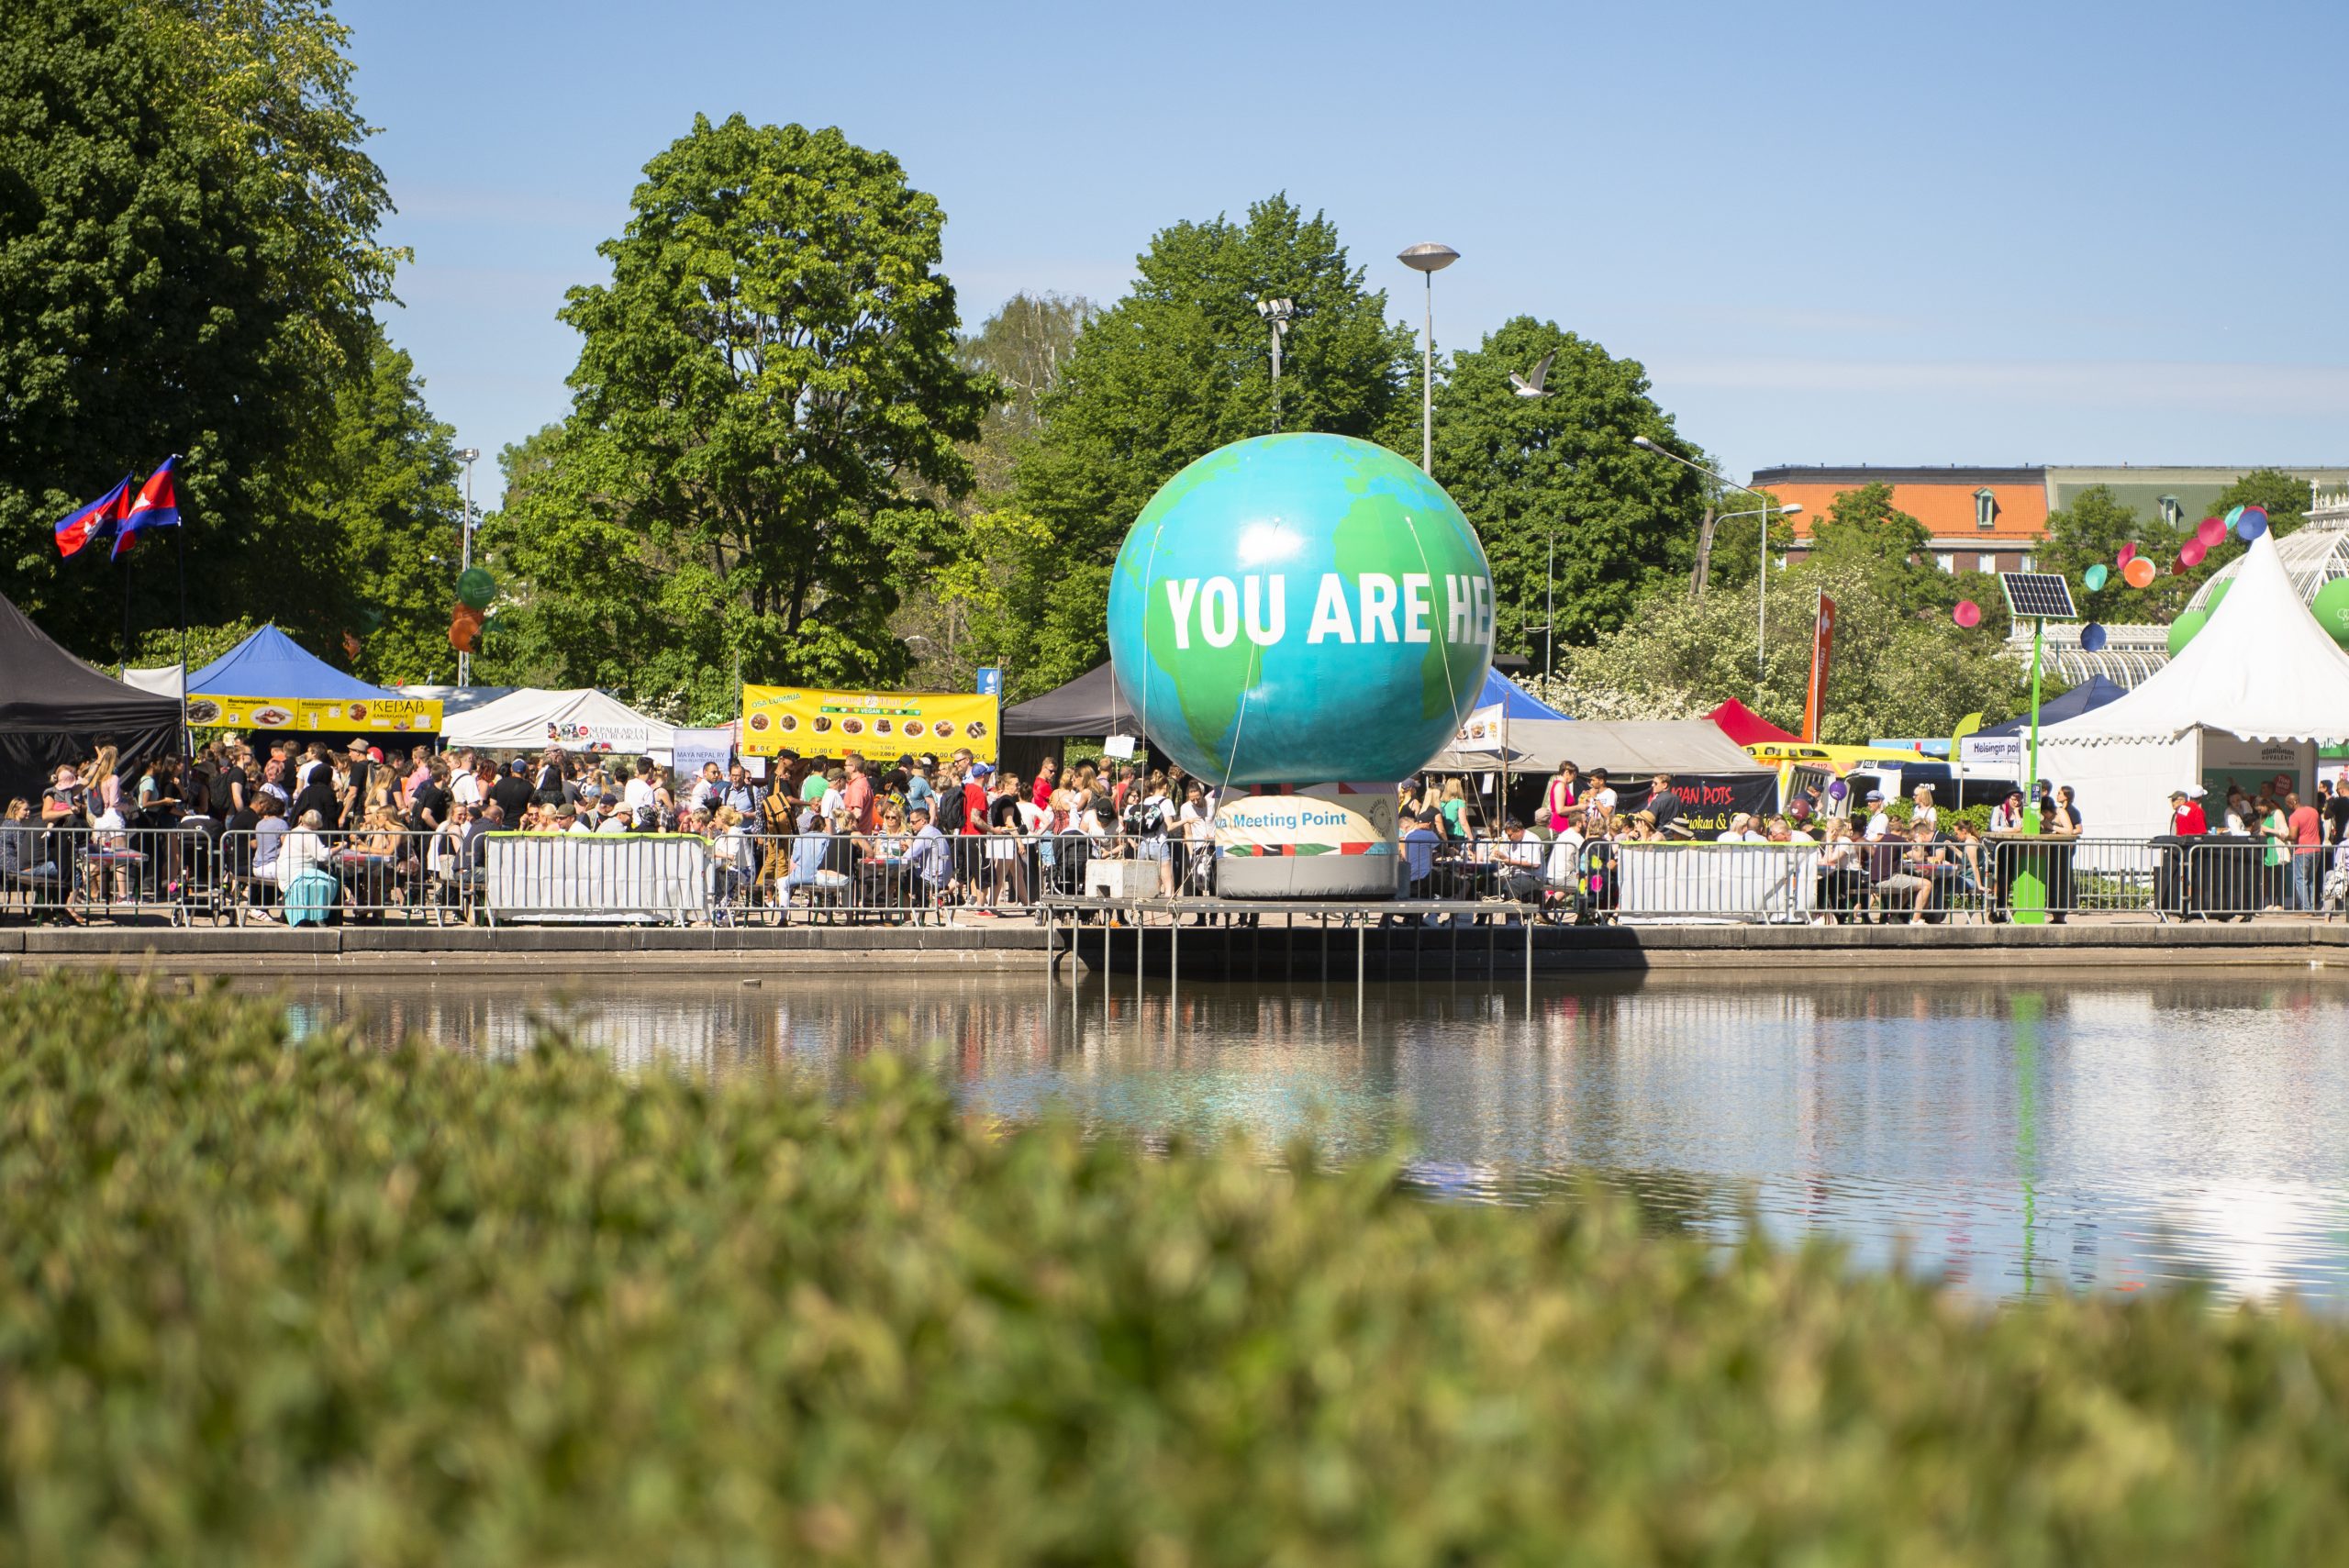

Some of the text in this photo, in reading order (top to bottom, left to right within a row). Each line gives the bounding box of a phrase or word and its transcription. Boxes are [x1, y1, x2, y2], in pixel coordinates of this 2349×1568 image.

[1165, 573, 1286, 650] YOU
[1307, 573, 1431, 645] ARE
[373, 700, 425, 714] KEBAB
[751, 693, 801, 708] OSA LUOMUA
[1974, 741, 2005, 755] Helsingin
[1233, 812, 1297, 829] Meeting
[1301, 810, 1347, 826] Point
[1716, 812, 1728, 829] &
